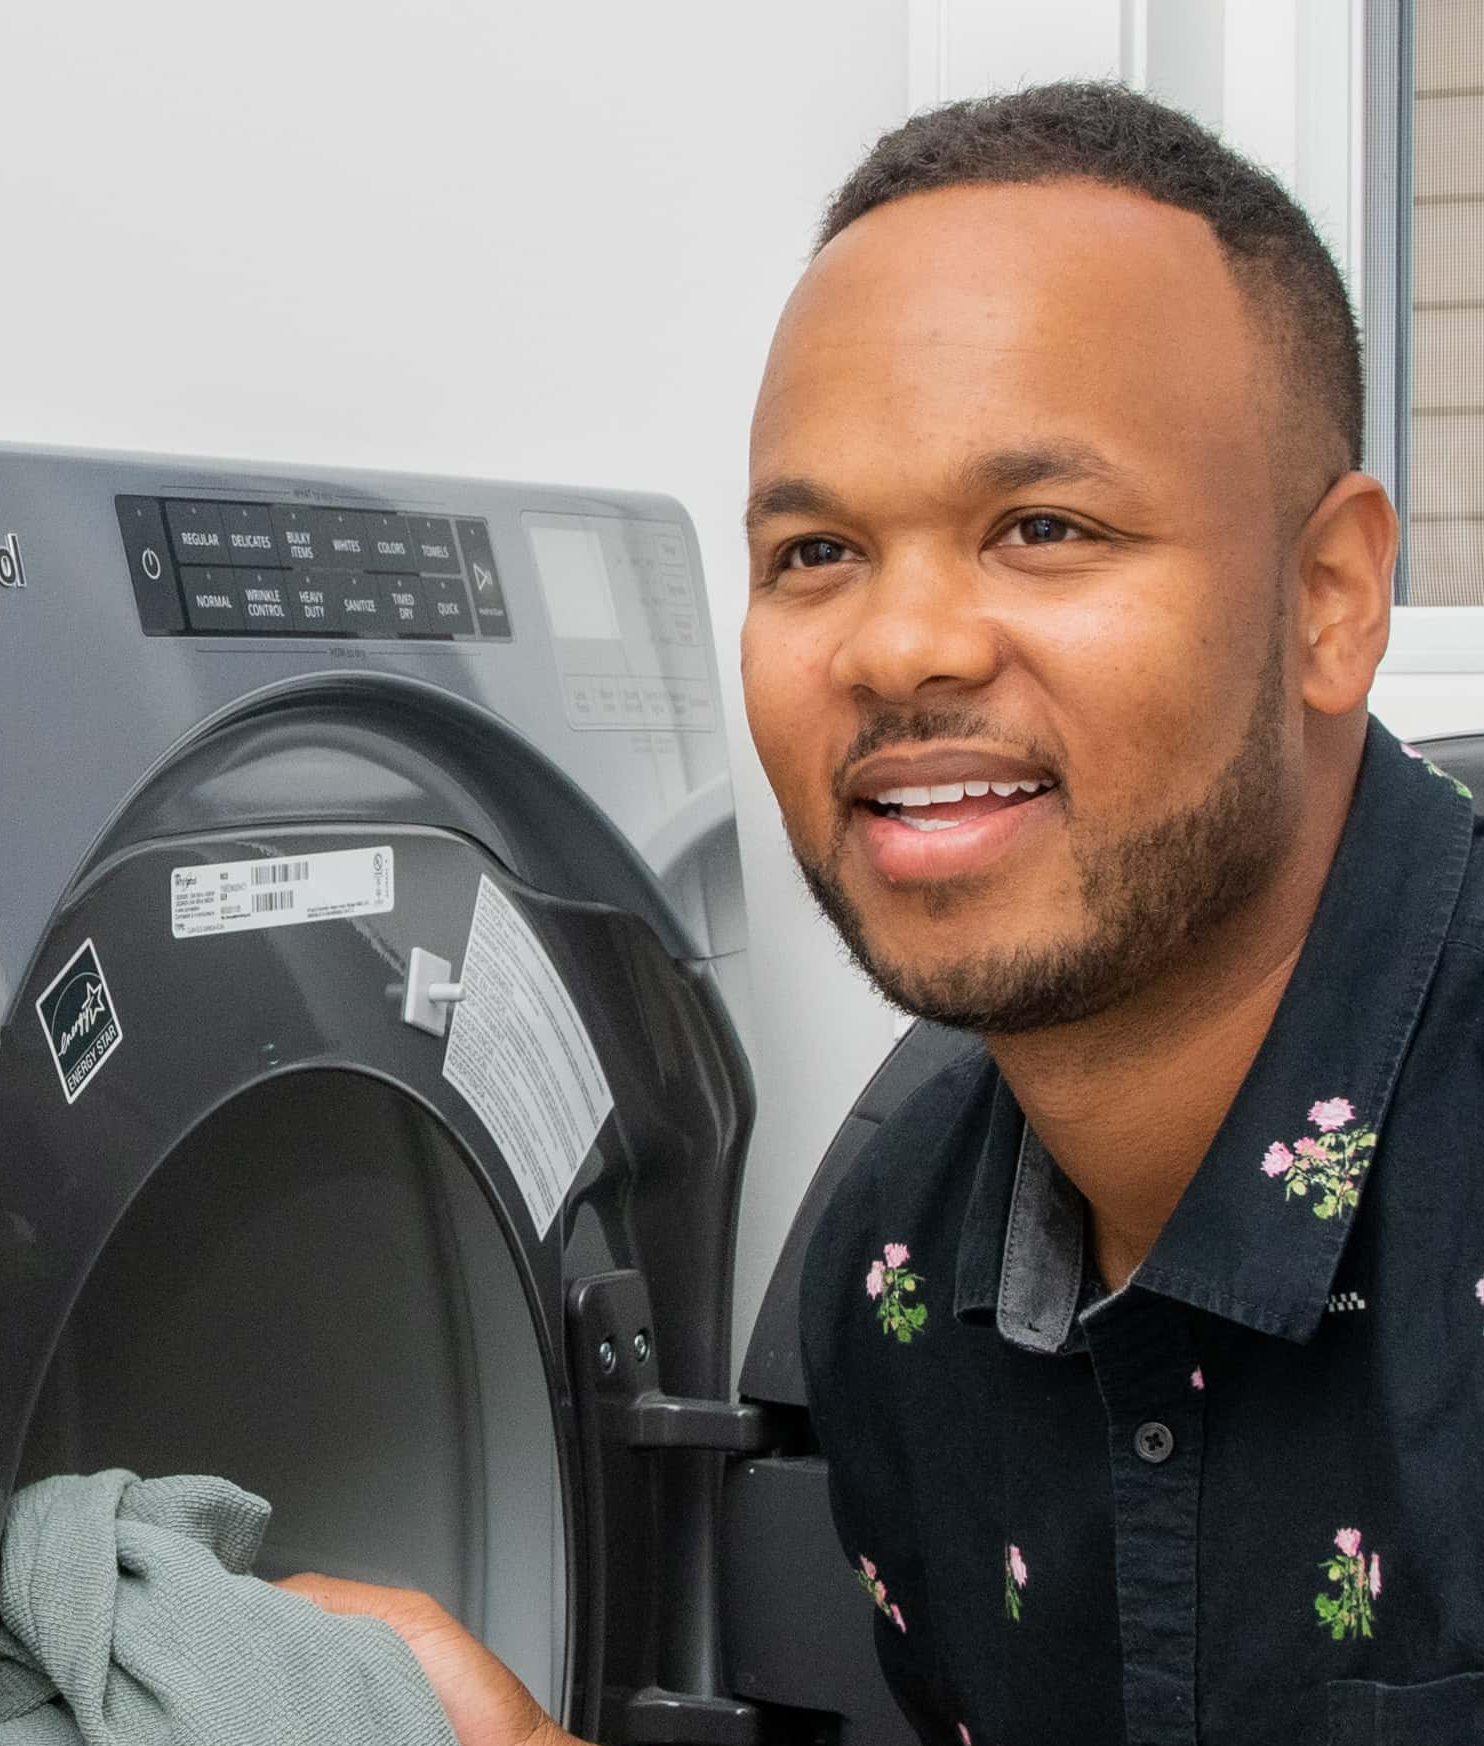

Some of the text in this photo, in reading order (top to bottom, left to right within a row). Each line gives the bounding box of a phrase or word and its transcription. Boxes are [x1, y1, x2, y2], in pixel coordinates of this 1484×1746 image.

[181, 532, 219, 546] REGULAR
[231, 534, 271, 549] DELICATES
[286, 531, 310, 545] BULKY
[291, 546, 314, 558] ITEMS
[332, 540, 361, 552] WHITES
[377, 542, 406, 555] COLORS
[421, 545, 449, 558] TOWELS
[196, 595, 232, 608] NORMAL
[245, 589, 280, 602] WRINKLE
[299, 591, 324, 603] HEAVY
[392, 593, 414, 605] TIMED
[248, 604, 285, 617] CONTROL
[304, 606, 324, 618] DUTY
[344, 599, 376, 613] SANITIZE
[437, 602, 459, 616] QUICK
[399, 608, 414, 620] DRY
[67, 1024, 117, 1092] ENERGY STAR
